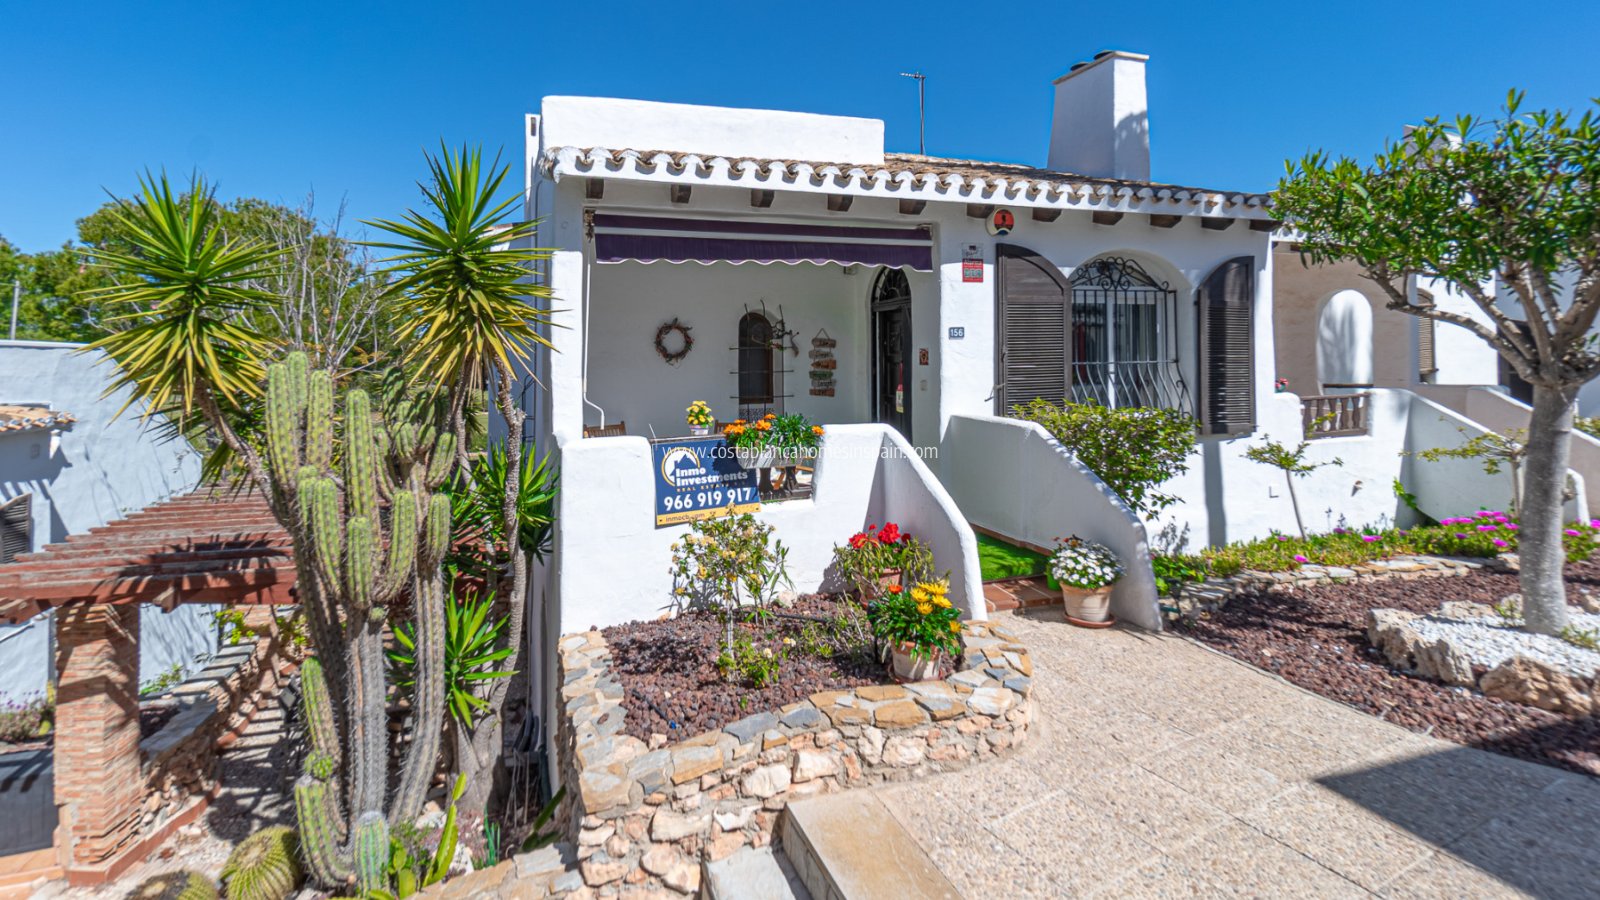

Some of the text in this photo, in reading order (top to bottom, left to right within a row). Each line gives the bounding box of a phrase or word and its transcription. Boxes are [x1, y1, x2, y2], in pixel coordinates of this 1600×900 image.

[950, 329, 963, 337] 156
[676, 467, 706, 477] Inmo
[676, 471, 748, 486] Investments
[664, 488, 751, 511] 966 919 917
